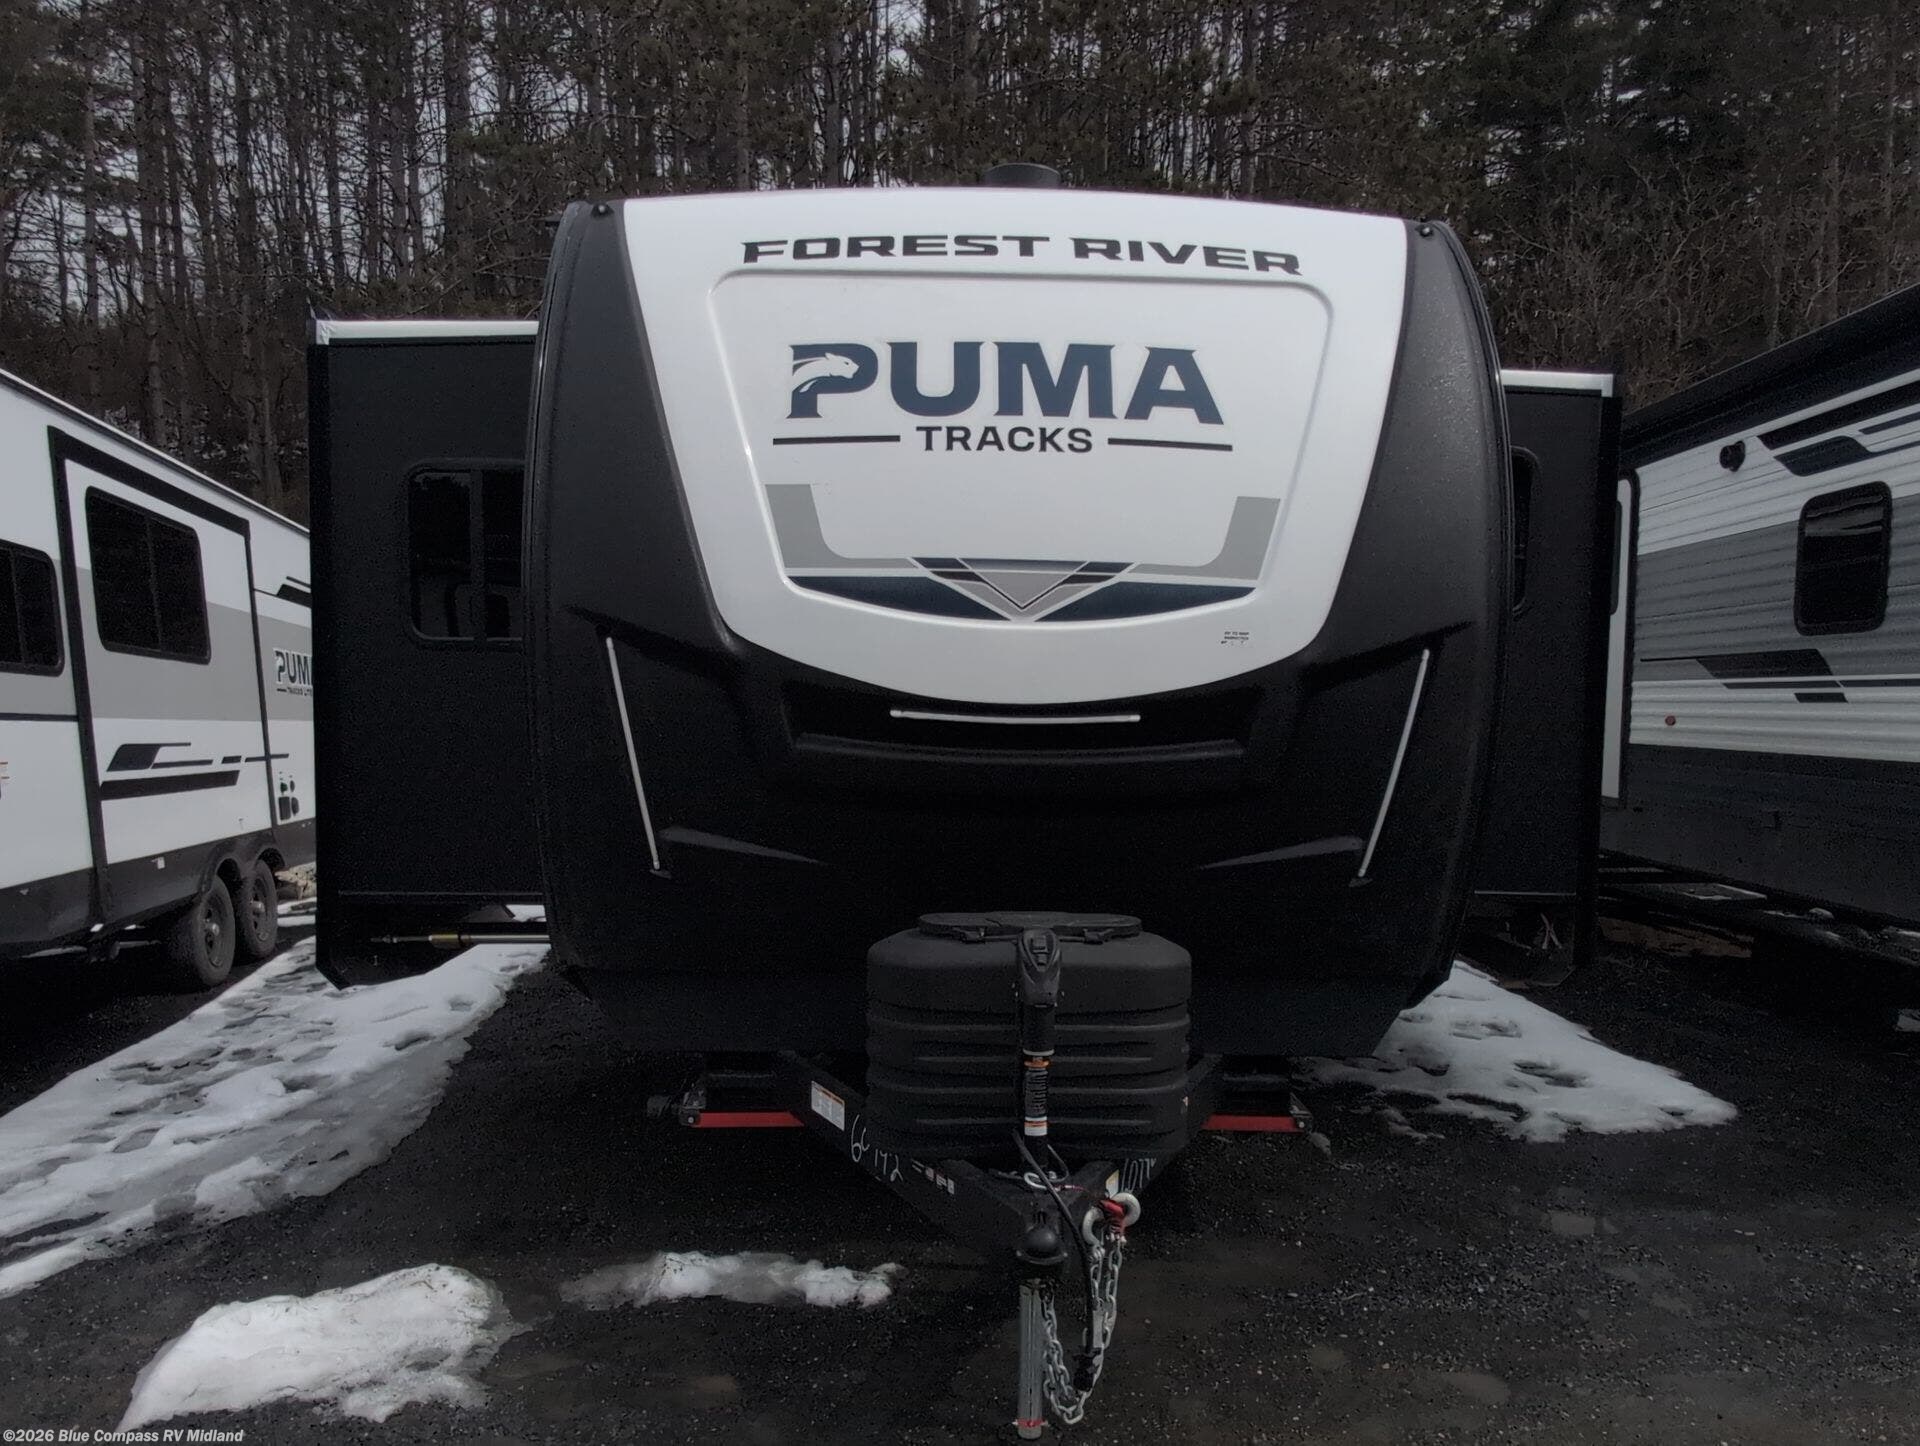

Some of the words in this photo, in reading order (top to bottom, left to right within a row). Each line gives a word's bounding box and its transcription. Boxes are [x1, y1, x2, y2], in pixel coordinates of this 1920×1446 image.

[741, 234, 1050, 264] FOREST
[1069, 236, 1303, 276] RIVER
[785, 340, 1225, 425] PUMA
[915, 425, 1094, 454] TRACKS
[275, 650, 313, 686] PUM
